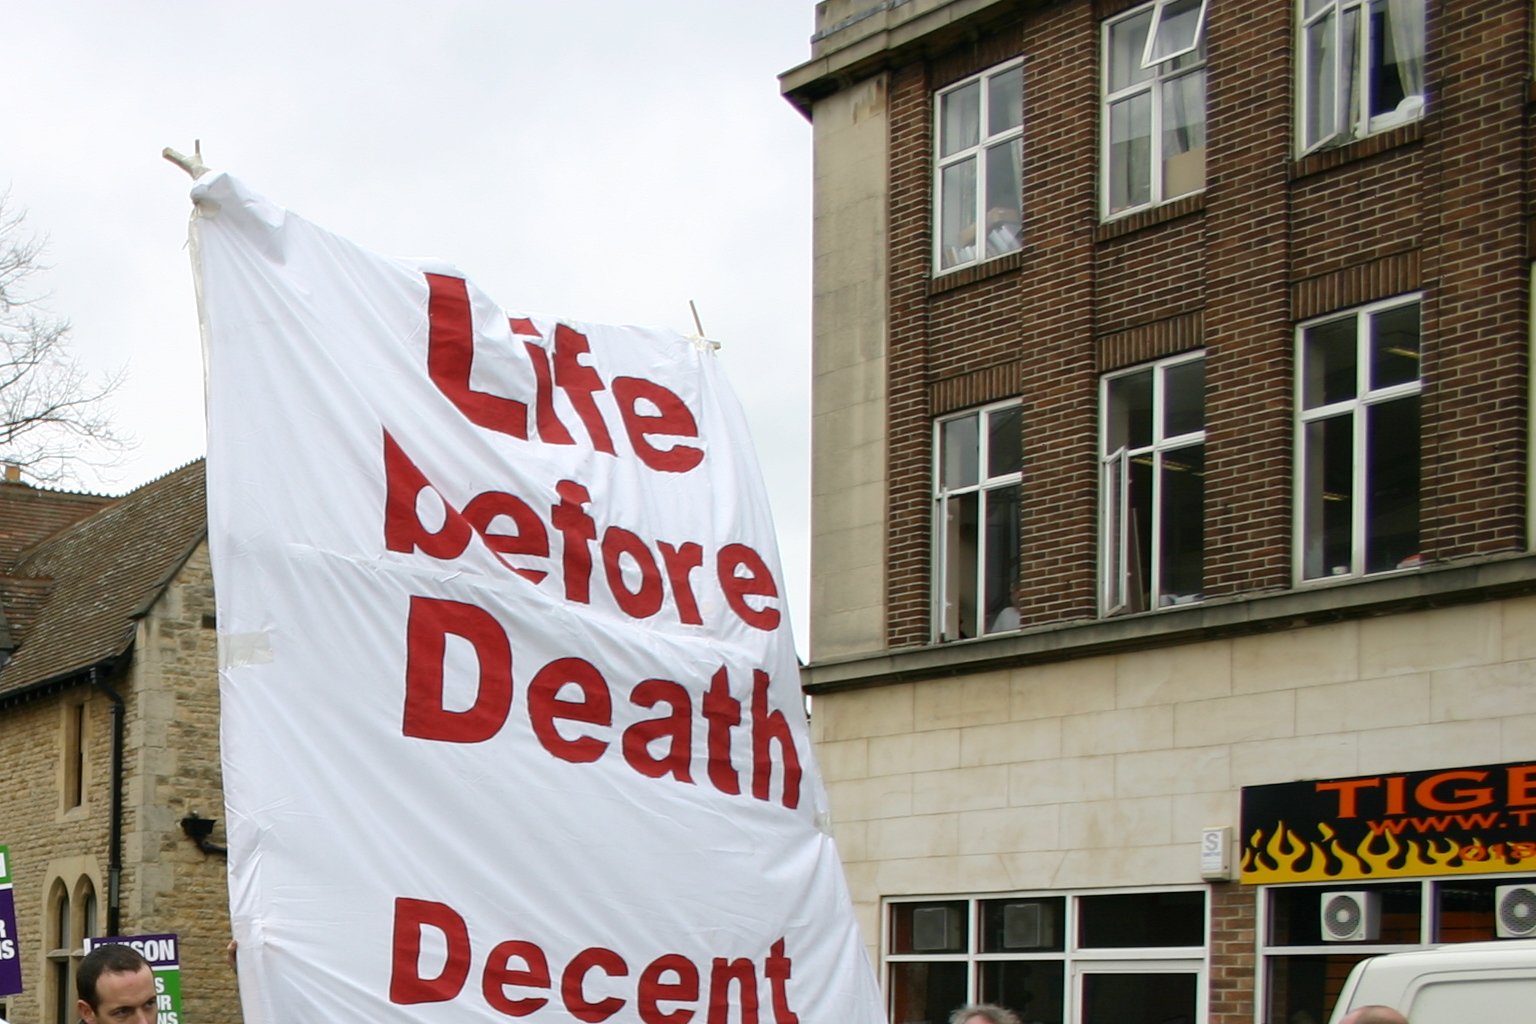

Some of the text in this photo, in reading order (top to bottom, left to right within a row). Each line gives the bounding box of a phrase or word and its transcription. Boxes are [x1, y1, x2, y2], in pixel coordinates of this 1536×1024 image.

[423, 271, 705, 474] Life
[382, 425, 781, 632] before
[402, 594, 803, 811] Death
[1316, 765, 1536, 819] TIGE
[94, 939, 175, 962] SON
